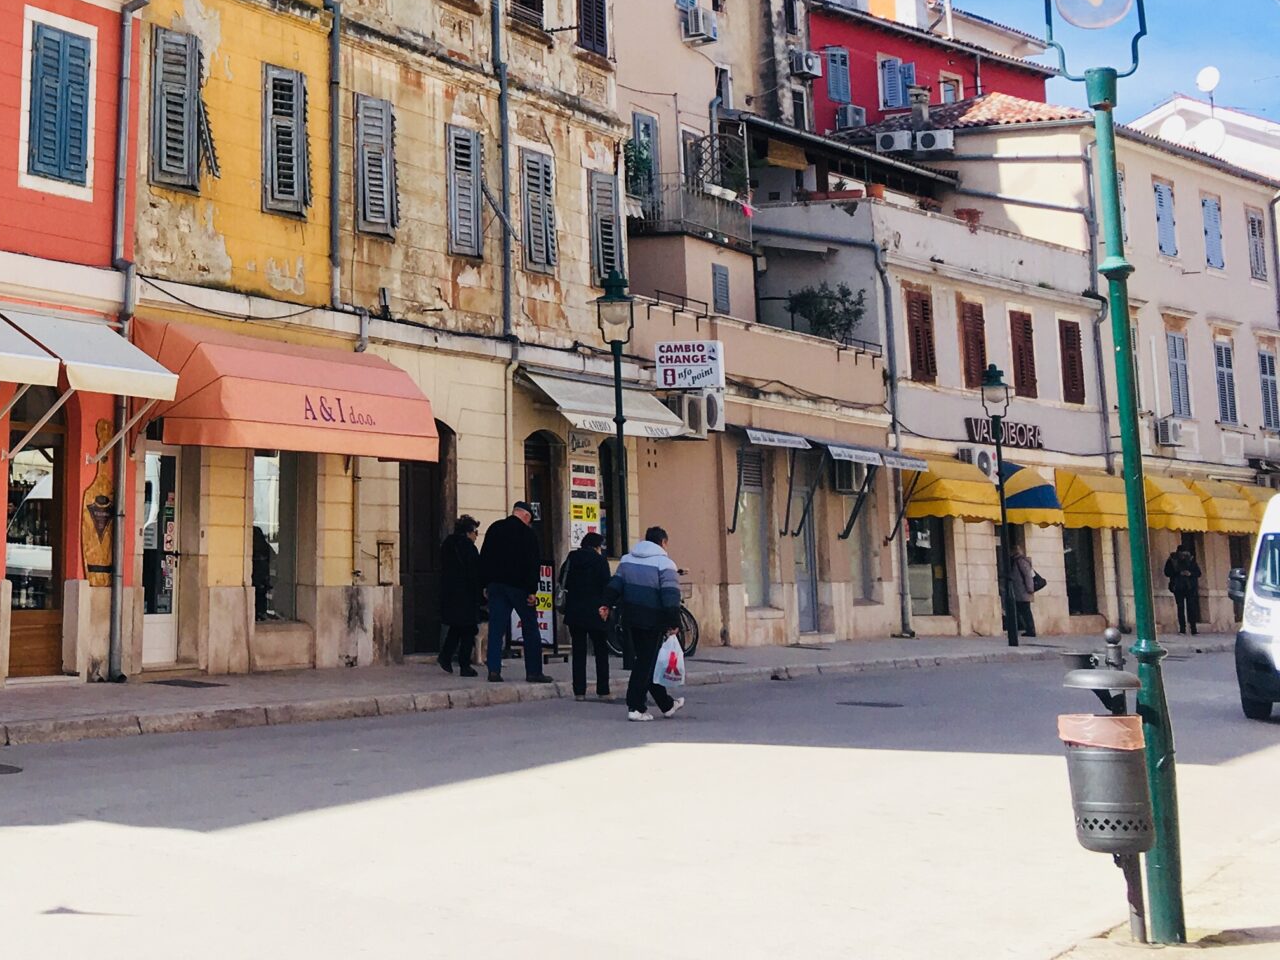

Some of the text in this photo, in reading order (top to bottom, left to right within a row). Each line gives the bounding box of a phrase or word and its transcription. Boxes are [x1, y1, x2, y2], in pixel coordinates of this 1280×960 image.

[658, 344, 705, 353] CAMBIO
[658, 355, 707, 364] CHANGE
[691, 367, 713, 385] point
[349, 406, 376, 426] d.o.o.
